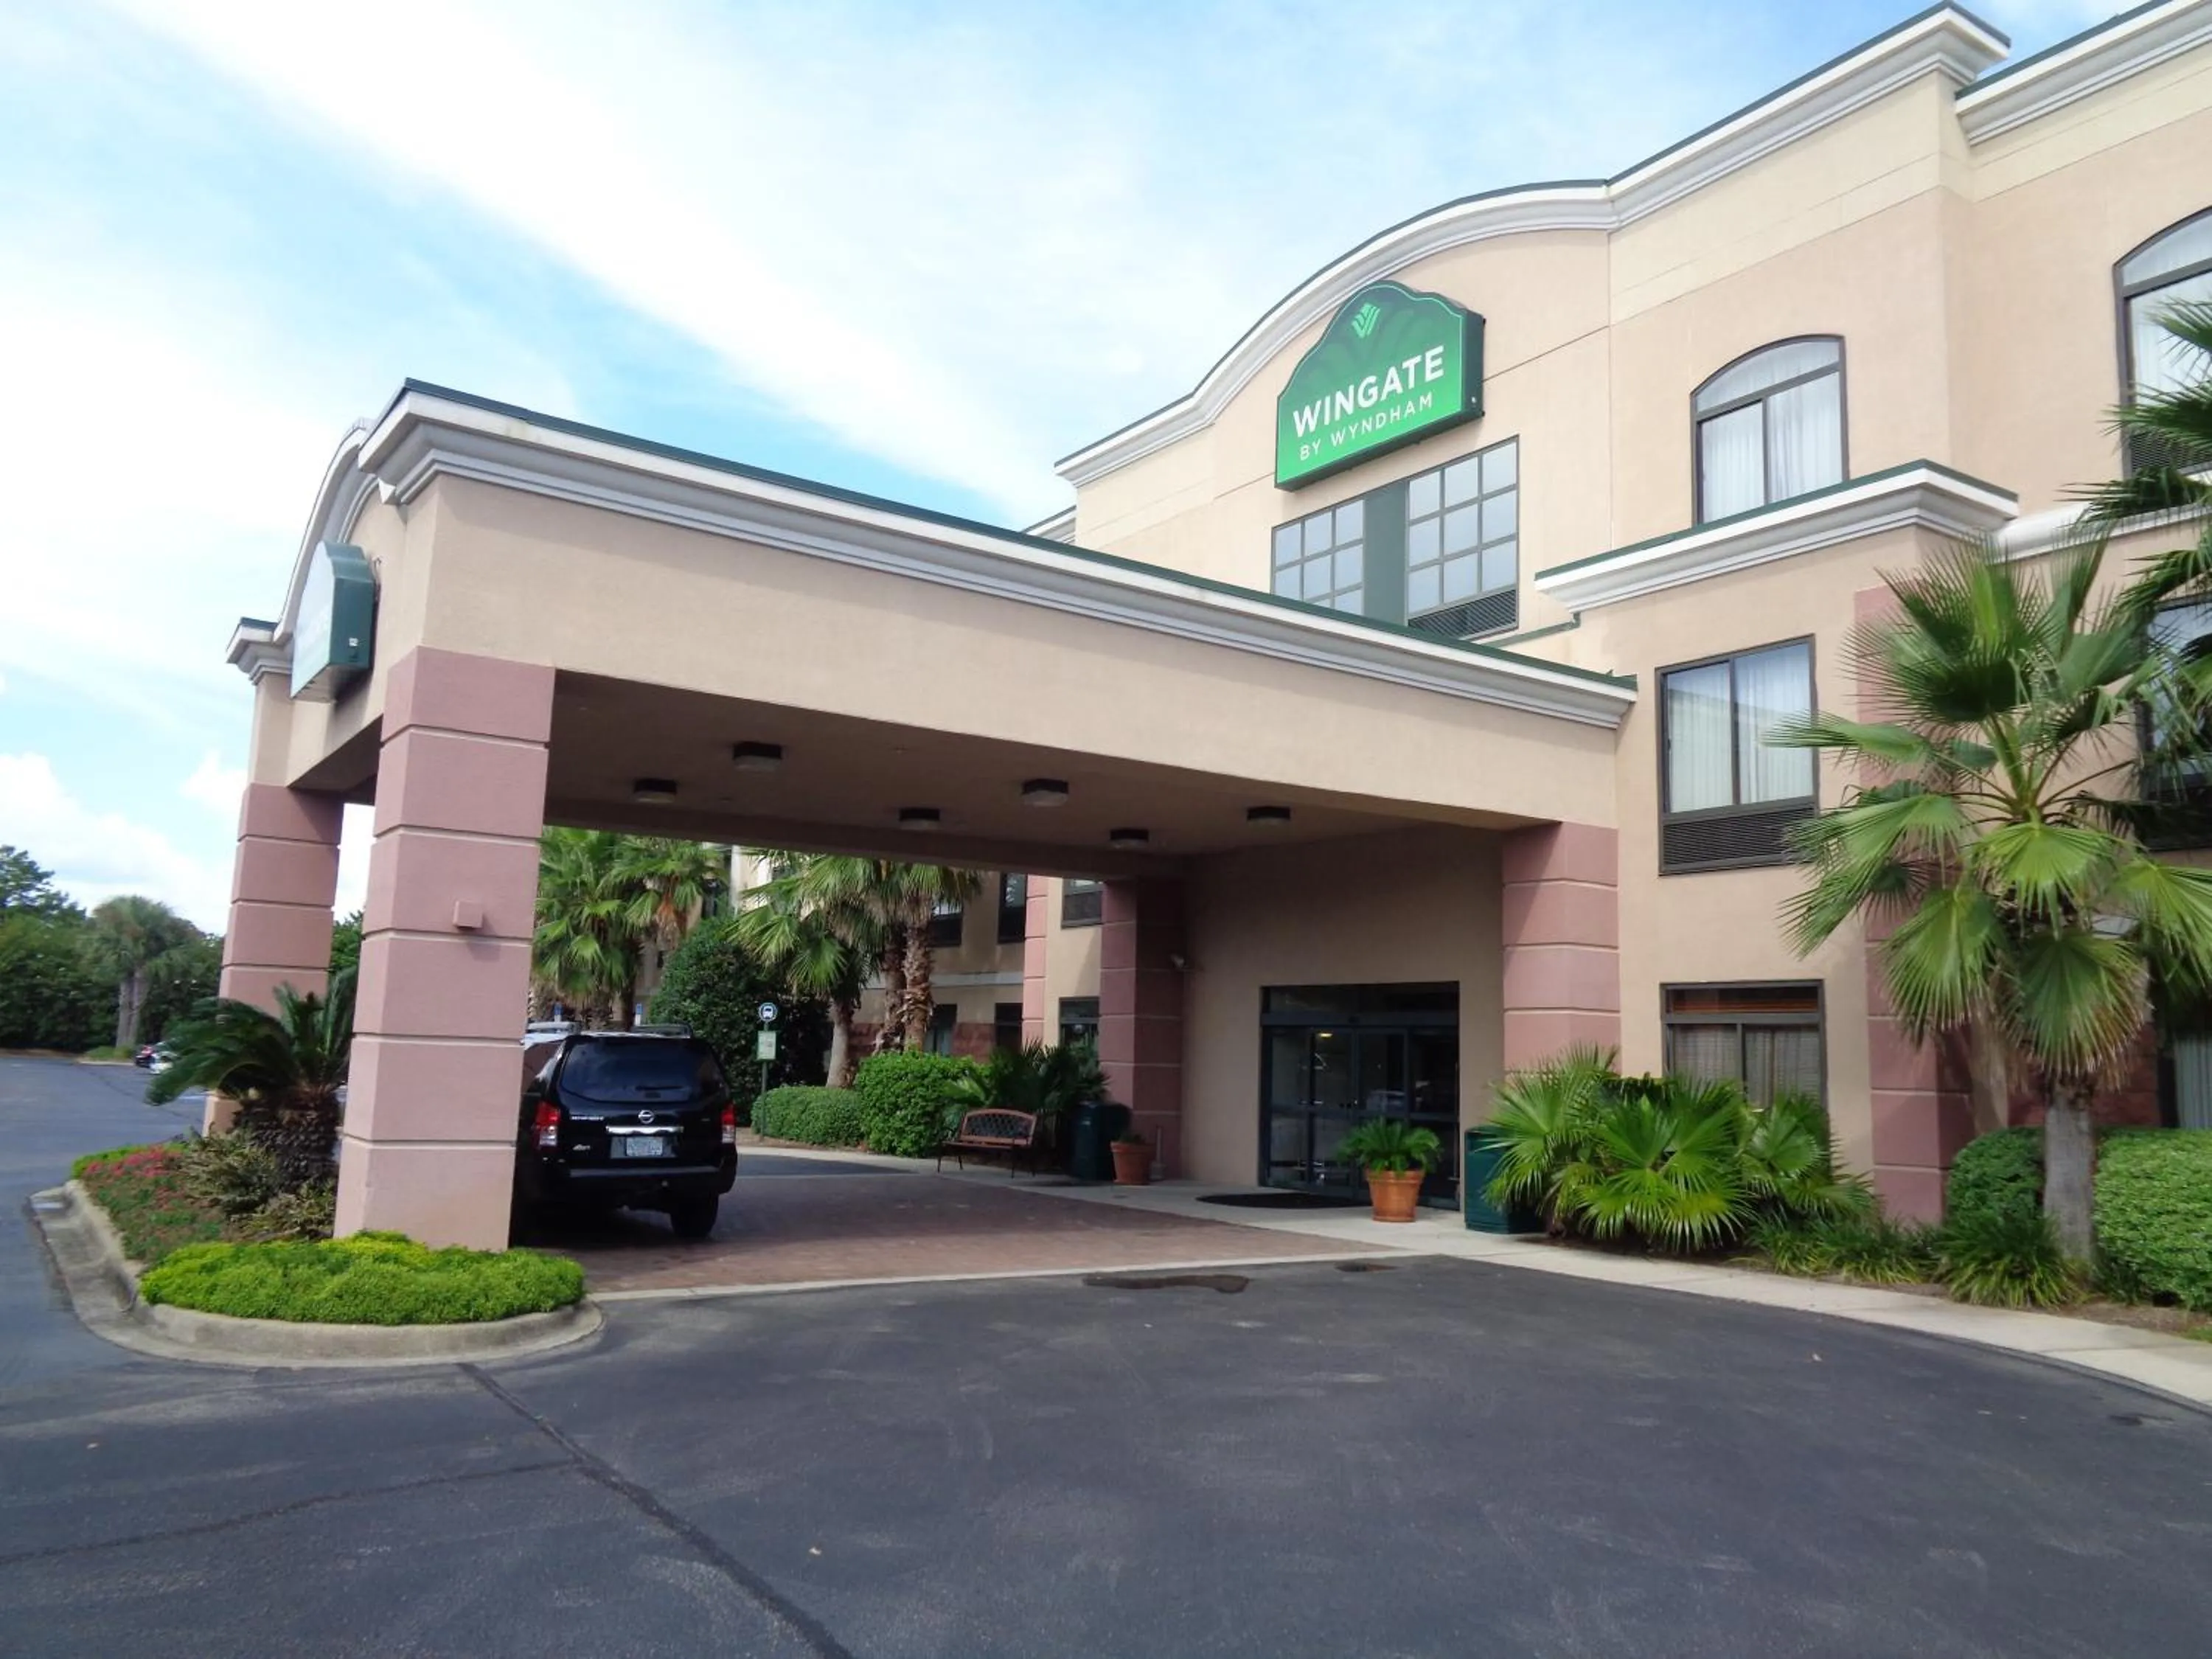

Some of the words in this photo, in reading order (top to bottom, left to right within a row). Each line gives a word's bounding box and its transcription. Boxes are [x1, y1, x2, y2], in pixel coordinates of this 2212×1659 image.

[1293, 345, 1444, 437] WINGATE
[1300, 440, 1321, 461] BY
[1331, 393, 1432, 447] WYNDHAM
